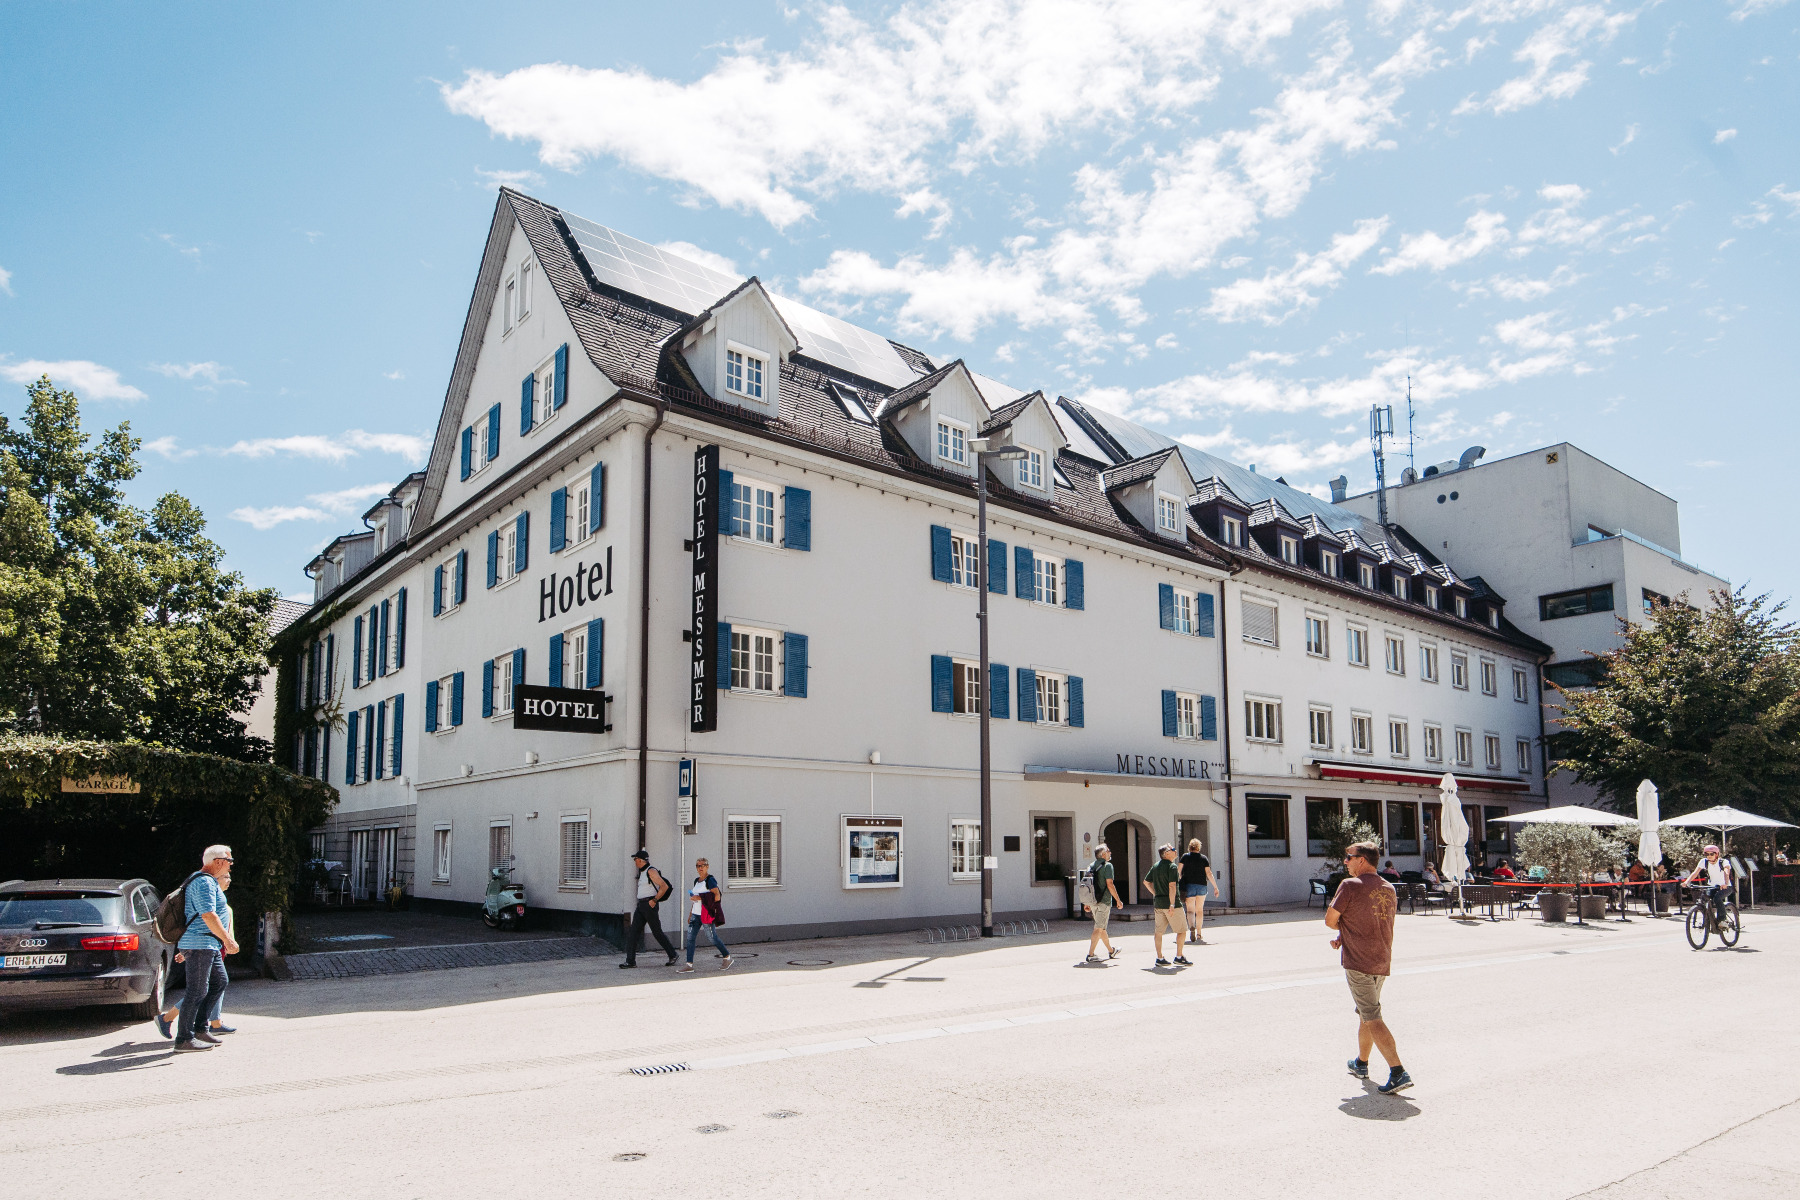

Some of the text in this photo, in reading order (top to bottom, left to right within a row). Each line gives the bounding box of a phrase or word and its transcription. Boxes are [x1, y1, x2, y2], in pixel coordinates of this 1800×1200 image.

[538, 545, 613, 623] Hotel
[693, 454, 707, 723] HOTEL MESSMER
[523, 698, 600, 720] HOTEL
[1116, 754, 1211, 779] MESSMER
[75, 780, 127, 790] GARAGE
[5, 956, 26, 967] ERH
[31, 955, 46, 965] KH
[47, 954, 66, 965] 647
